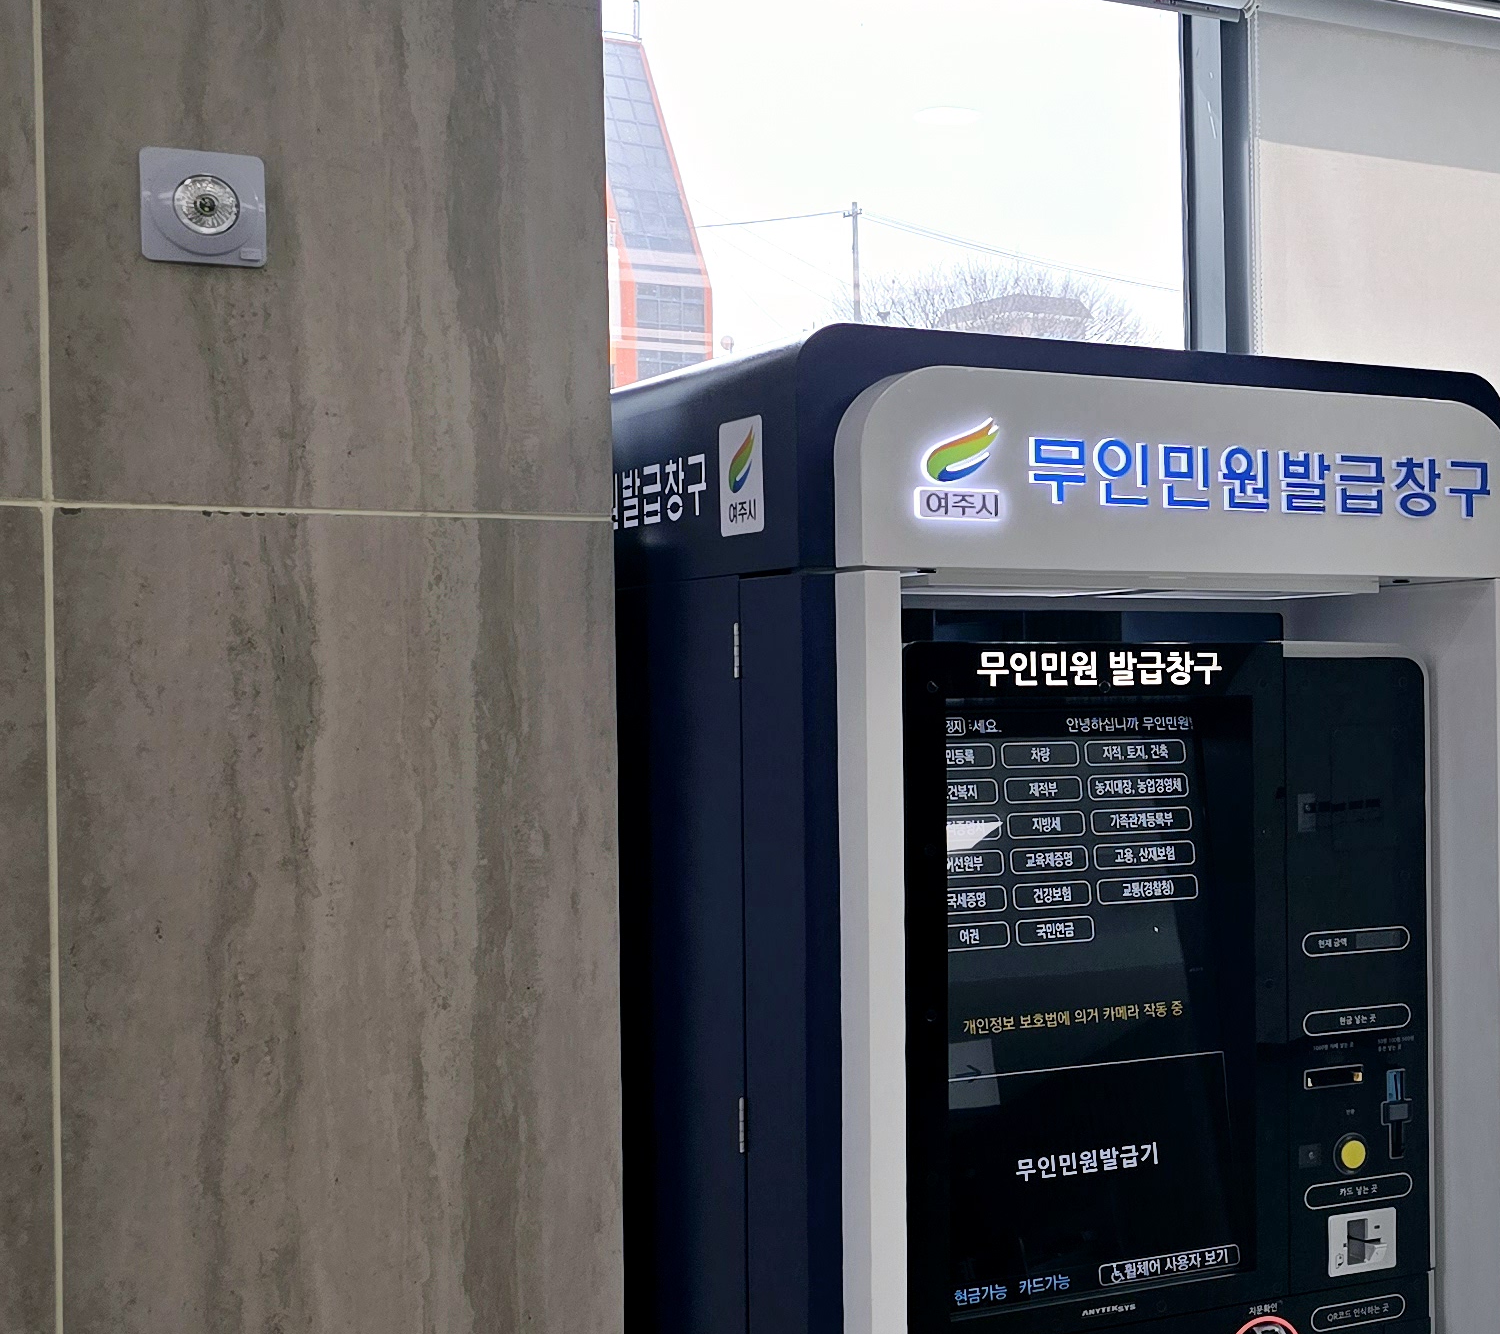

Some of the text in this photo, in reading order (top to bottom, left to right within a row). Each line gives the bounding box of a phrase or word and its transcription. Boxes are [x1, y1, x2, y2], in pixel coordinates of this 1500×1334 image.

[1026, 433, 1493, 521] 무인민원발급창구
[729, 499, 756, 524] 여주시
[921, 493, 1001, 521] 여주시
[976, 651, 1222, 687] 무인민원 발급창구
[1066, 717, 1138, 733] 안녕하십니까
[1030, 747, 1050, 762] 차량
[1102, 744, 1169, 760] 지적, 토지, 건축
[1029, 782, 1058, 797] 제적부
[1095, 778, 1182, 795] 농지대장, 농업경영체
[1032, 817, 1062, 832] 지방세
[1110, 813, 1174, 828] 가족관계등록부
[1025, 851, 1073, 868] 교육제증명
[1114, 845, 1176, 864] 고용, 산재보험
[1033, 886, 1072, 903] 건강보험
[1122, 880, 1175, 897] 교통(경찰청)
[947, 891, 987, 908] 국세증명
[959, 929, 980, 944] 여권
[1036, 922, 1075, 939] 국민연금
[963, 1000, 1184, 1036] 개인정보 보호법에 의거 카메라 작동 중
[1016, 1140, 1160, 1182] 무인민원발급기
[1124, 1248, 1229, 1280] 휠체어 사용자 보기
[954, 1274, 1071, 1306] 현금가능 카드가능
[1248, 1302, 1278, 1316] 지문확인
[1327, 1310, 1352, 1323] QR코드
[1381, 1303, 1389, 1313] 곳
